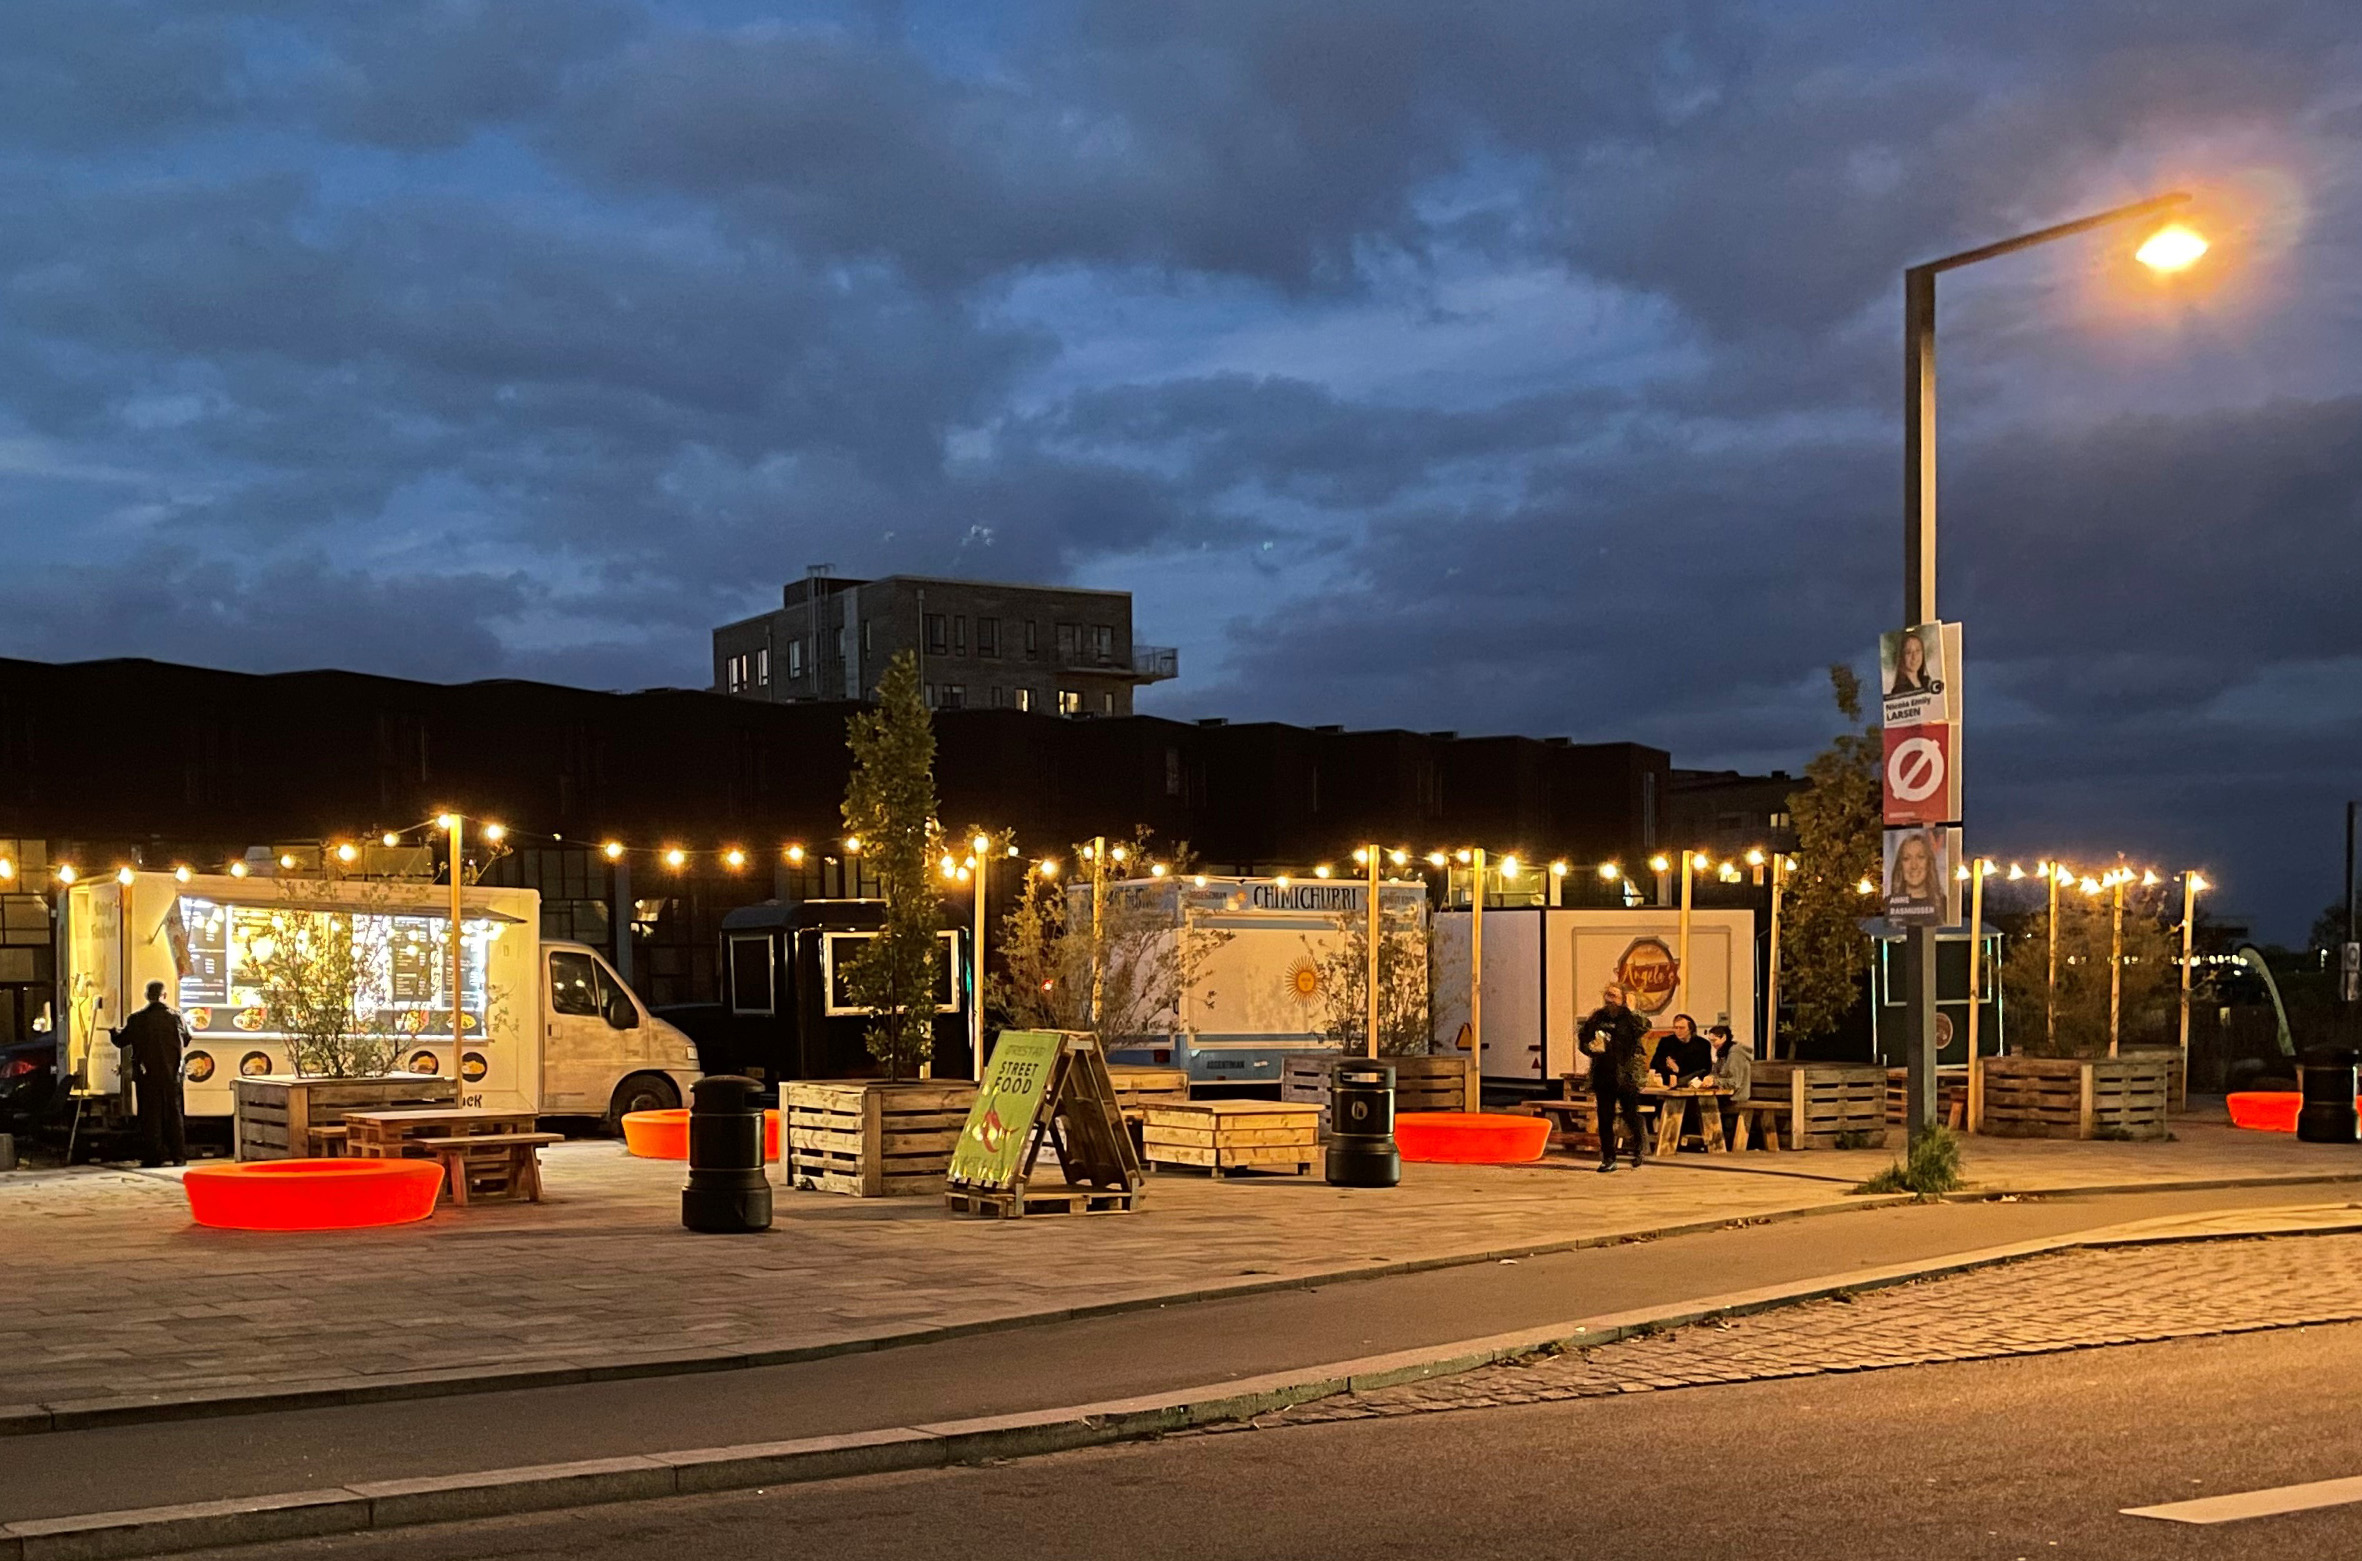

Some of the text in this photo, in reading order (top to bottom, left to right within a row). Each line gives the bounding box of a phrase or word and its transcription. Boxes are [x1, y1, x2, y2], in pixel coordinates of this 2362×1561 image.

[1886, 707, 1921, 721] LARSEN
[1253, 886, 1357, 910] CHIMICHURRI
[1890, 906, 1935, 915] RASMUSSEN
[999, 1061, 1039, 1076] STREET
[994, 1076, 1033, 1094] FOOD
